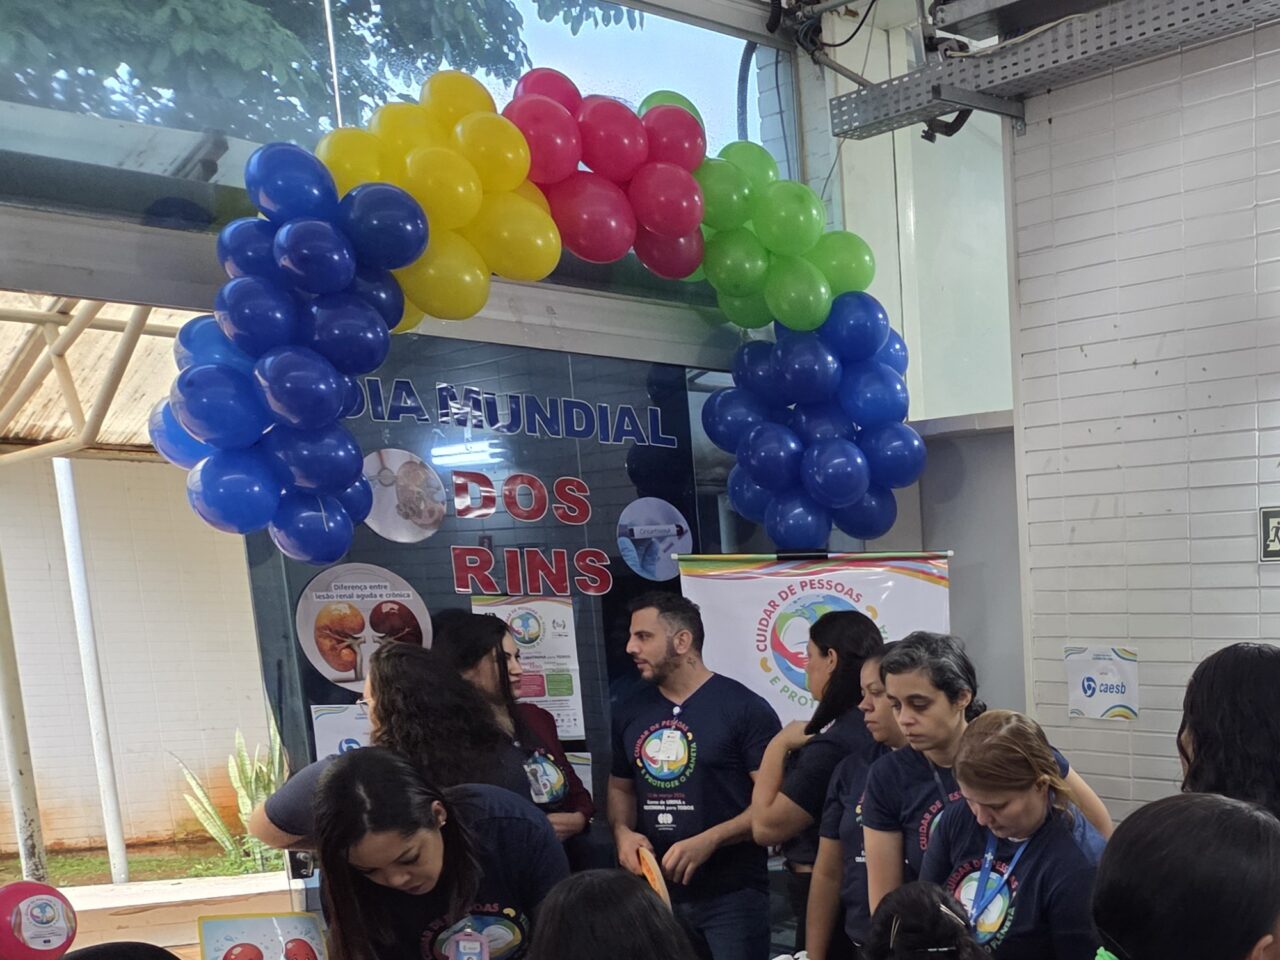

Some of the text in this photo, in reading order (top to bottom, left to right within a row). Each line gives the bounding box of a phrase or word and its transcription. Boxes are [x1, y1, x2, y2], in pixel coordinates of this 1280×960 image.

[436, 382, 677, 448] MUNDIAL
[452, 470, 592, 525] DOS
[450, 545, 613, 596] RINS
[756, 579, 863, 652] CUIDAR DE PESSOAS
[769, 676, 814, 708] E PROT
[1100, 682, 1126, 694] caesb
[634, 730, 649, 757] CUIDAR
[650, 723, 659, 731] DE
[644, 774, 680, 788] PROTEGER
[686, 742, 697, 776] PLANETA
[919, 800, 943, 850] CUIDAR DE
[948, 863, 972, 889] UIDAR
[990, 906, 1015, 949] PLANETA
